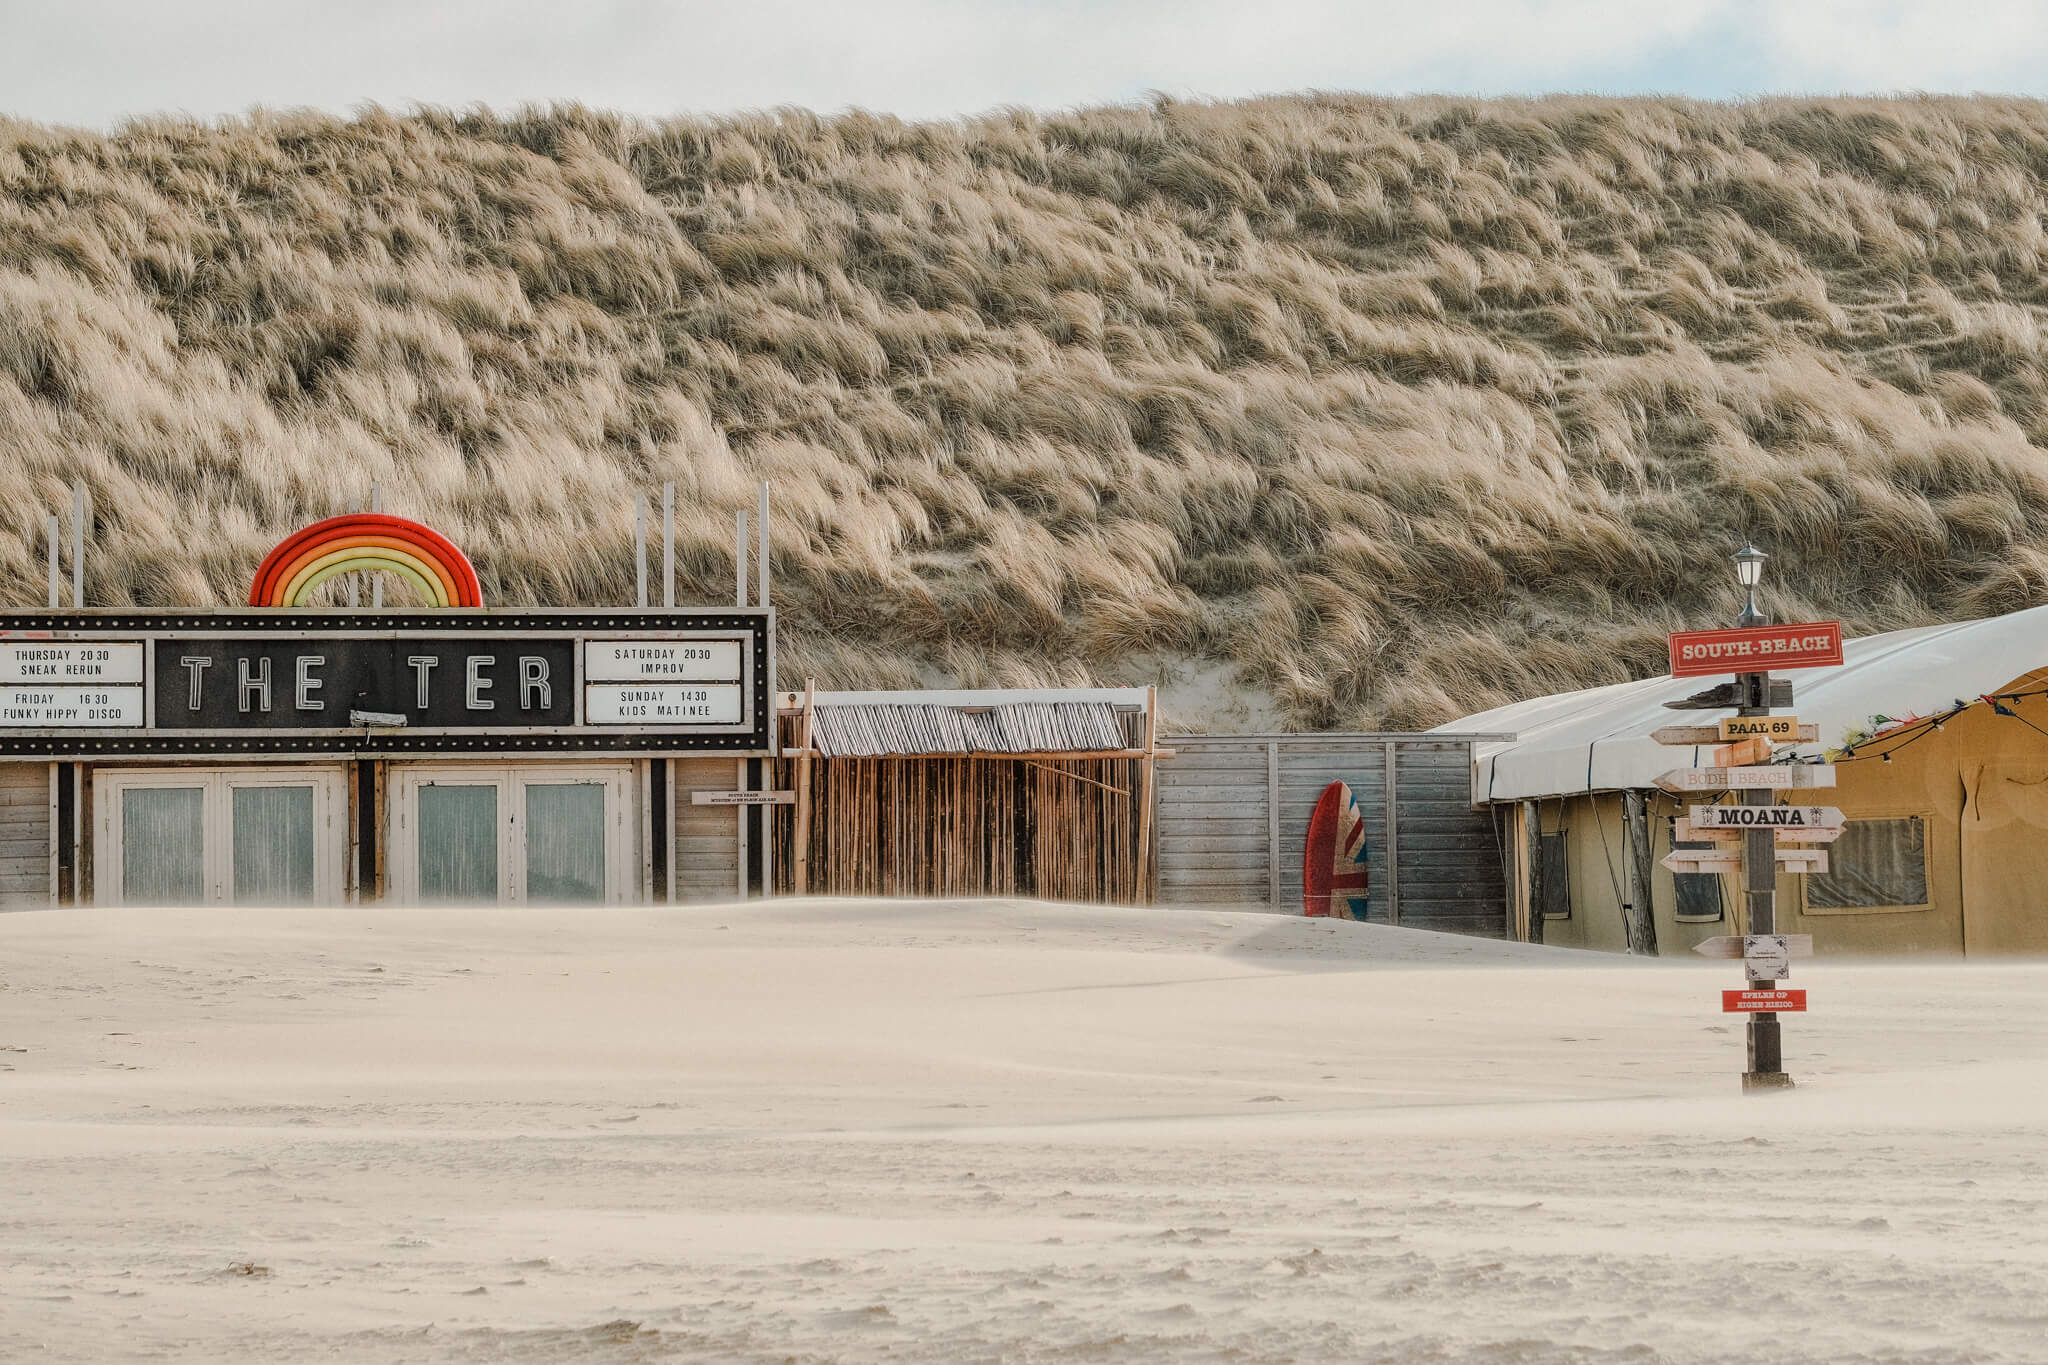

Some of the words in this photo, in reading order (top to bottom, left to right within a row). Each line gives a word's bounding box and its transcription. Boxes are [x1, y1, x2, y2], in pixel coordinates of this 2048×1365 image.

[1682, 635, 1831, 660] SOUTH-BEACH
[15, 650, 70, 661] THURSDAY
[615, 649, 675, 660] SATURDAY
[21, 664, 57, 675] SNEAK
[66, 664, 101, 675] RERUN
[641, 663, 684, 674] IMPROV
[15, 693, 54, 704] FRIDAY
[620, 691, 664, 702] SUNDAY
[4, 708, 39, 719] FUNKY
[46, 708, 78, 719] HIPPY
[88, 708, 122, 719] DISCO
[619, 705, 647, 716] KIDS
[657, 705, 710, 716] MATINEE
[1728, 722, 1769, 734] PAAL
[1772, 722, 1790, 733] 69
[1688, 774, 1734, 785] BODHI
[1737, 772, 1787, 785] BEACH
[1718, 809, 1805, 825] MOANA
